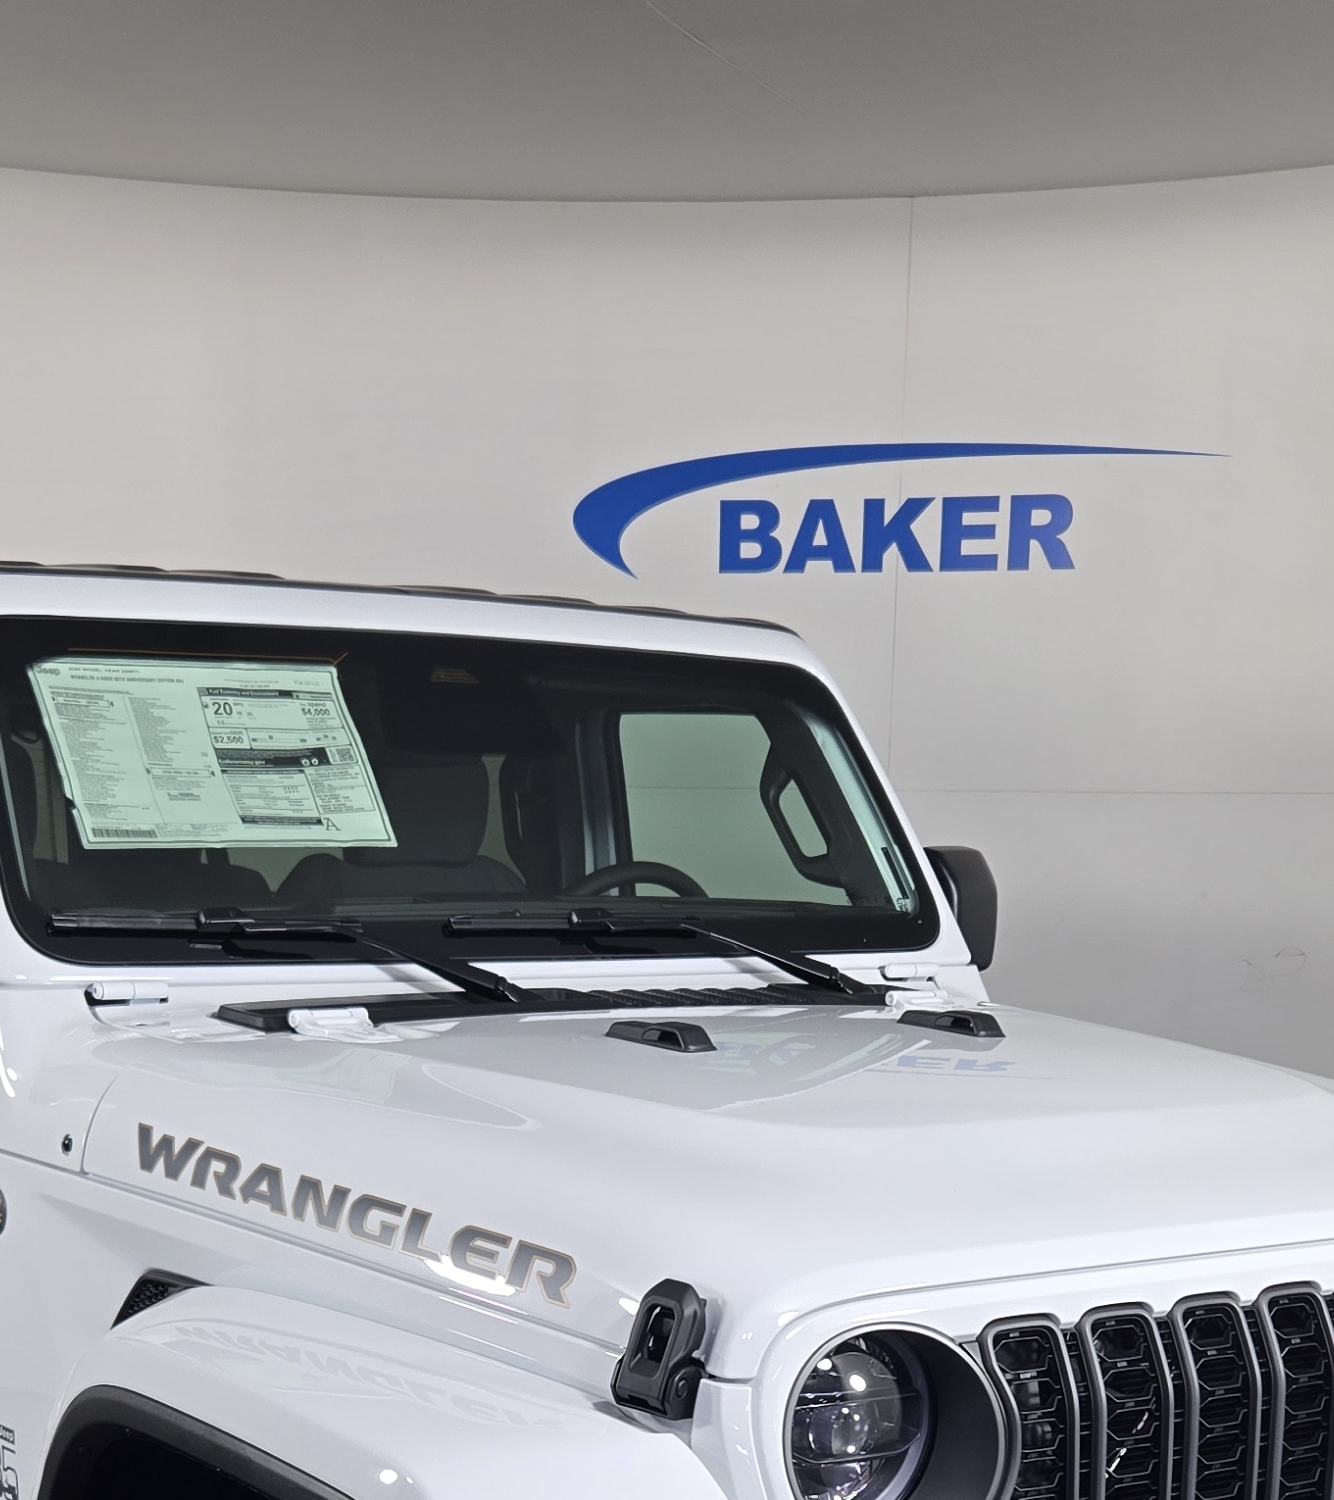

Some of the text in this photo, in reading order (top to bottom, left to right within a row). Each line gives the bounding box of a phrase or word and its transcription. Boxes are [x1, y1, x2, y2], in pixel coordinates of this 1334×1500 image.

[719, 494, 1075, 573] BAKER
[212, 702, 233, 716] 20
[301, 708, 331, 717] $4,000
[213, 736, 244, 744] $2,500
[138, 1122, 577, 1309] WRANGLER
[0, 1426, 14, 1442] Jeep
